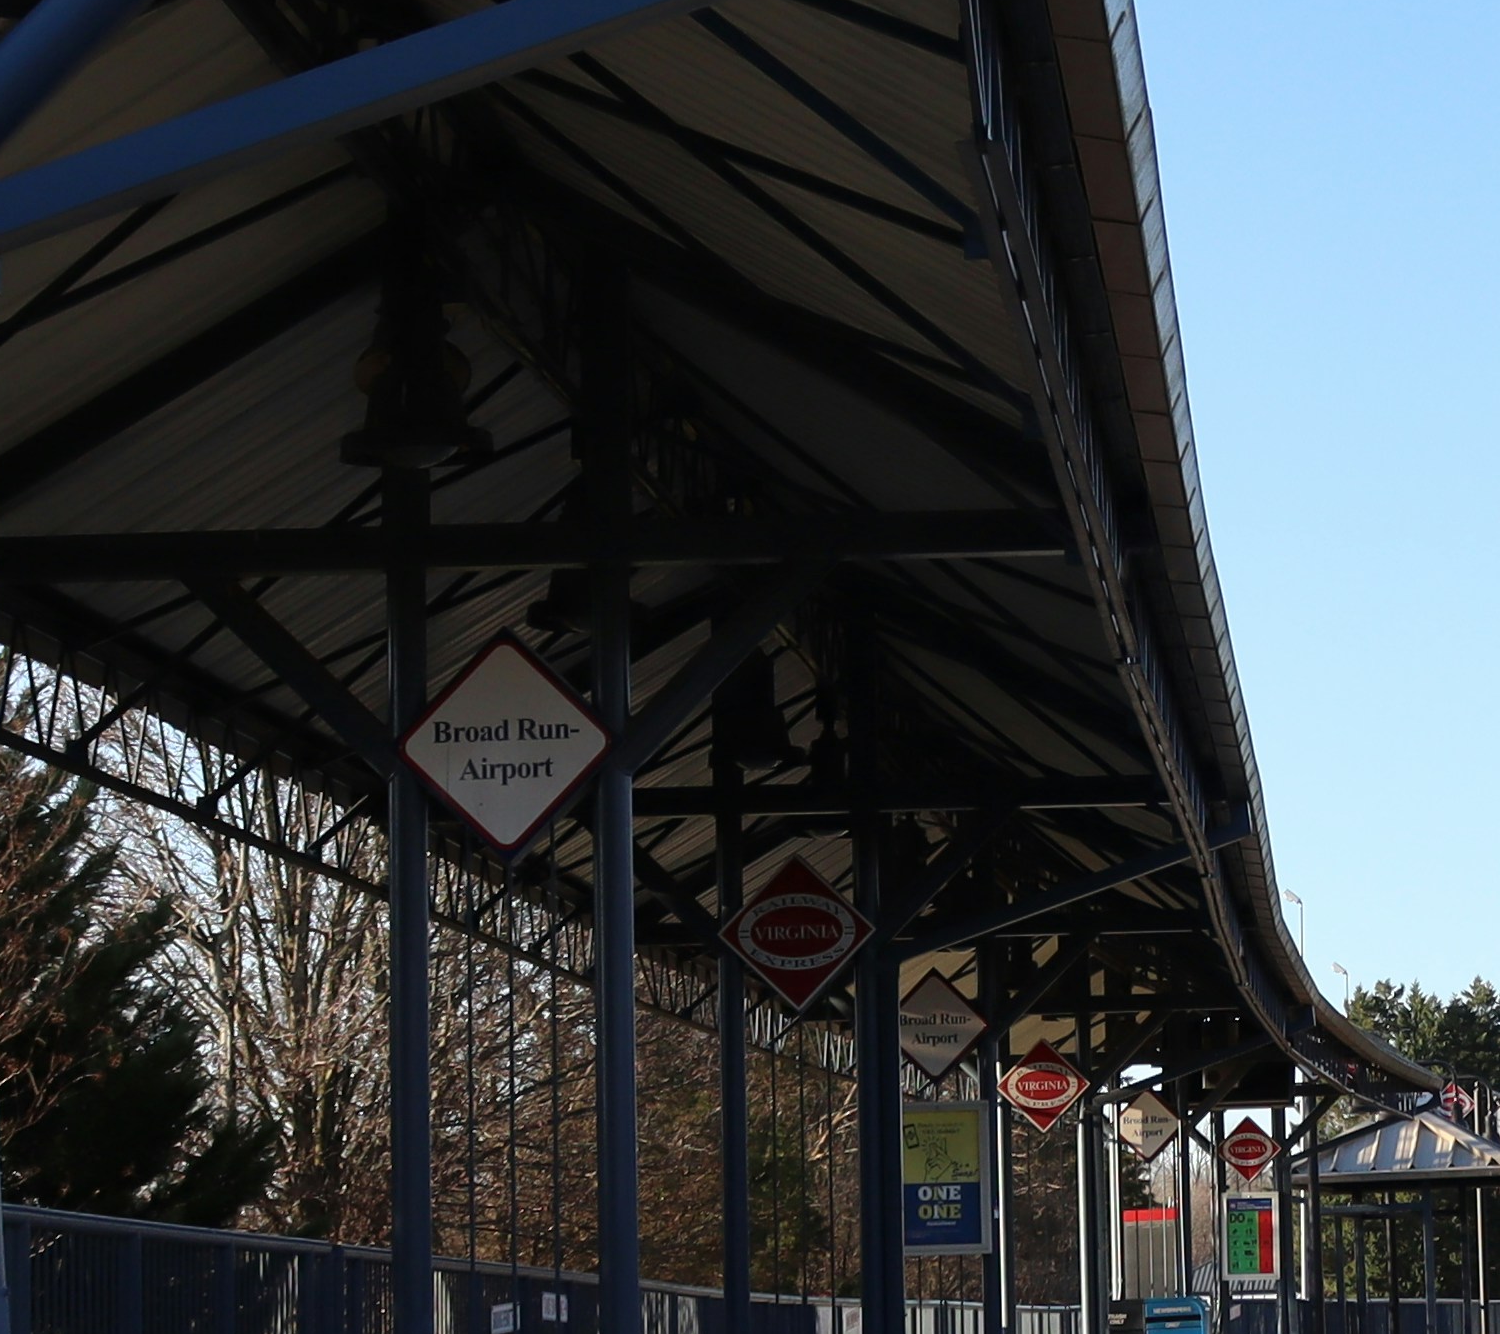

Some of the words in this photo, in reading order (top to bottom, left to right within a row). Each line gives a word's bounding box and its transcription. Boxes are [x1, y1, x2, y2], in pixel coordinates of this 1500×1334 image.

[432, 719, 509, 744] Broad
[516, 718, 580, 741] Run-
[458, 757, 554, 786] Airport
[754, 924, 840, 941] VIRGINIA
[899, 1013, 937, 1026] Broad
[940, 1013, 971, 1025] Run-
[912, 1032, 959, 1047] Airport
[1017, 1080, 1069, 1092] VIRGINIA
[917, 1185, 961, 1201] ONE
[918, 1204, 961, 1219] ONE
